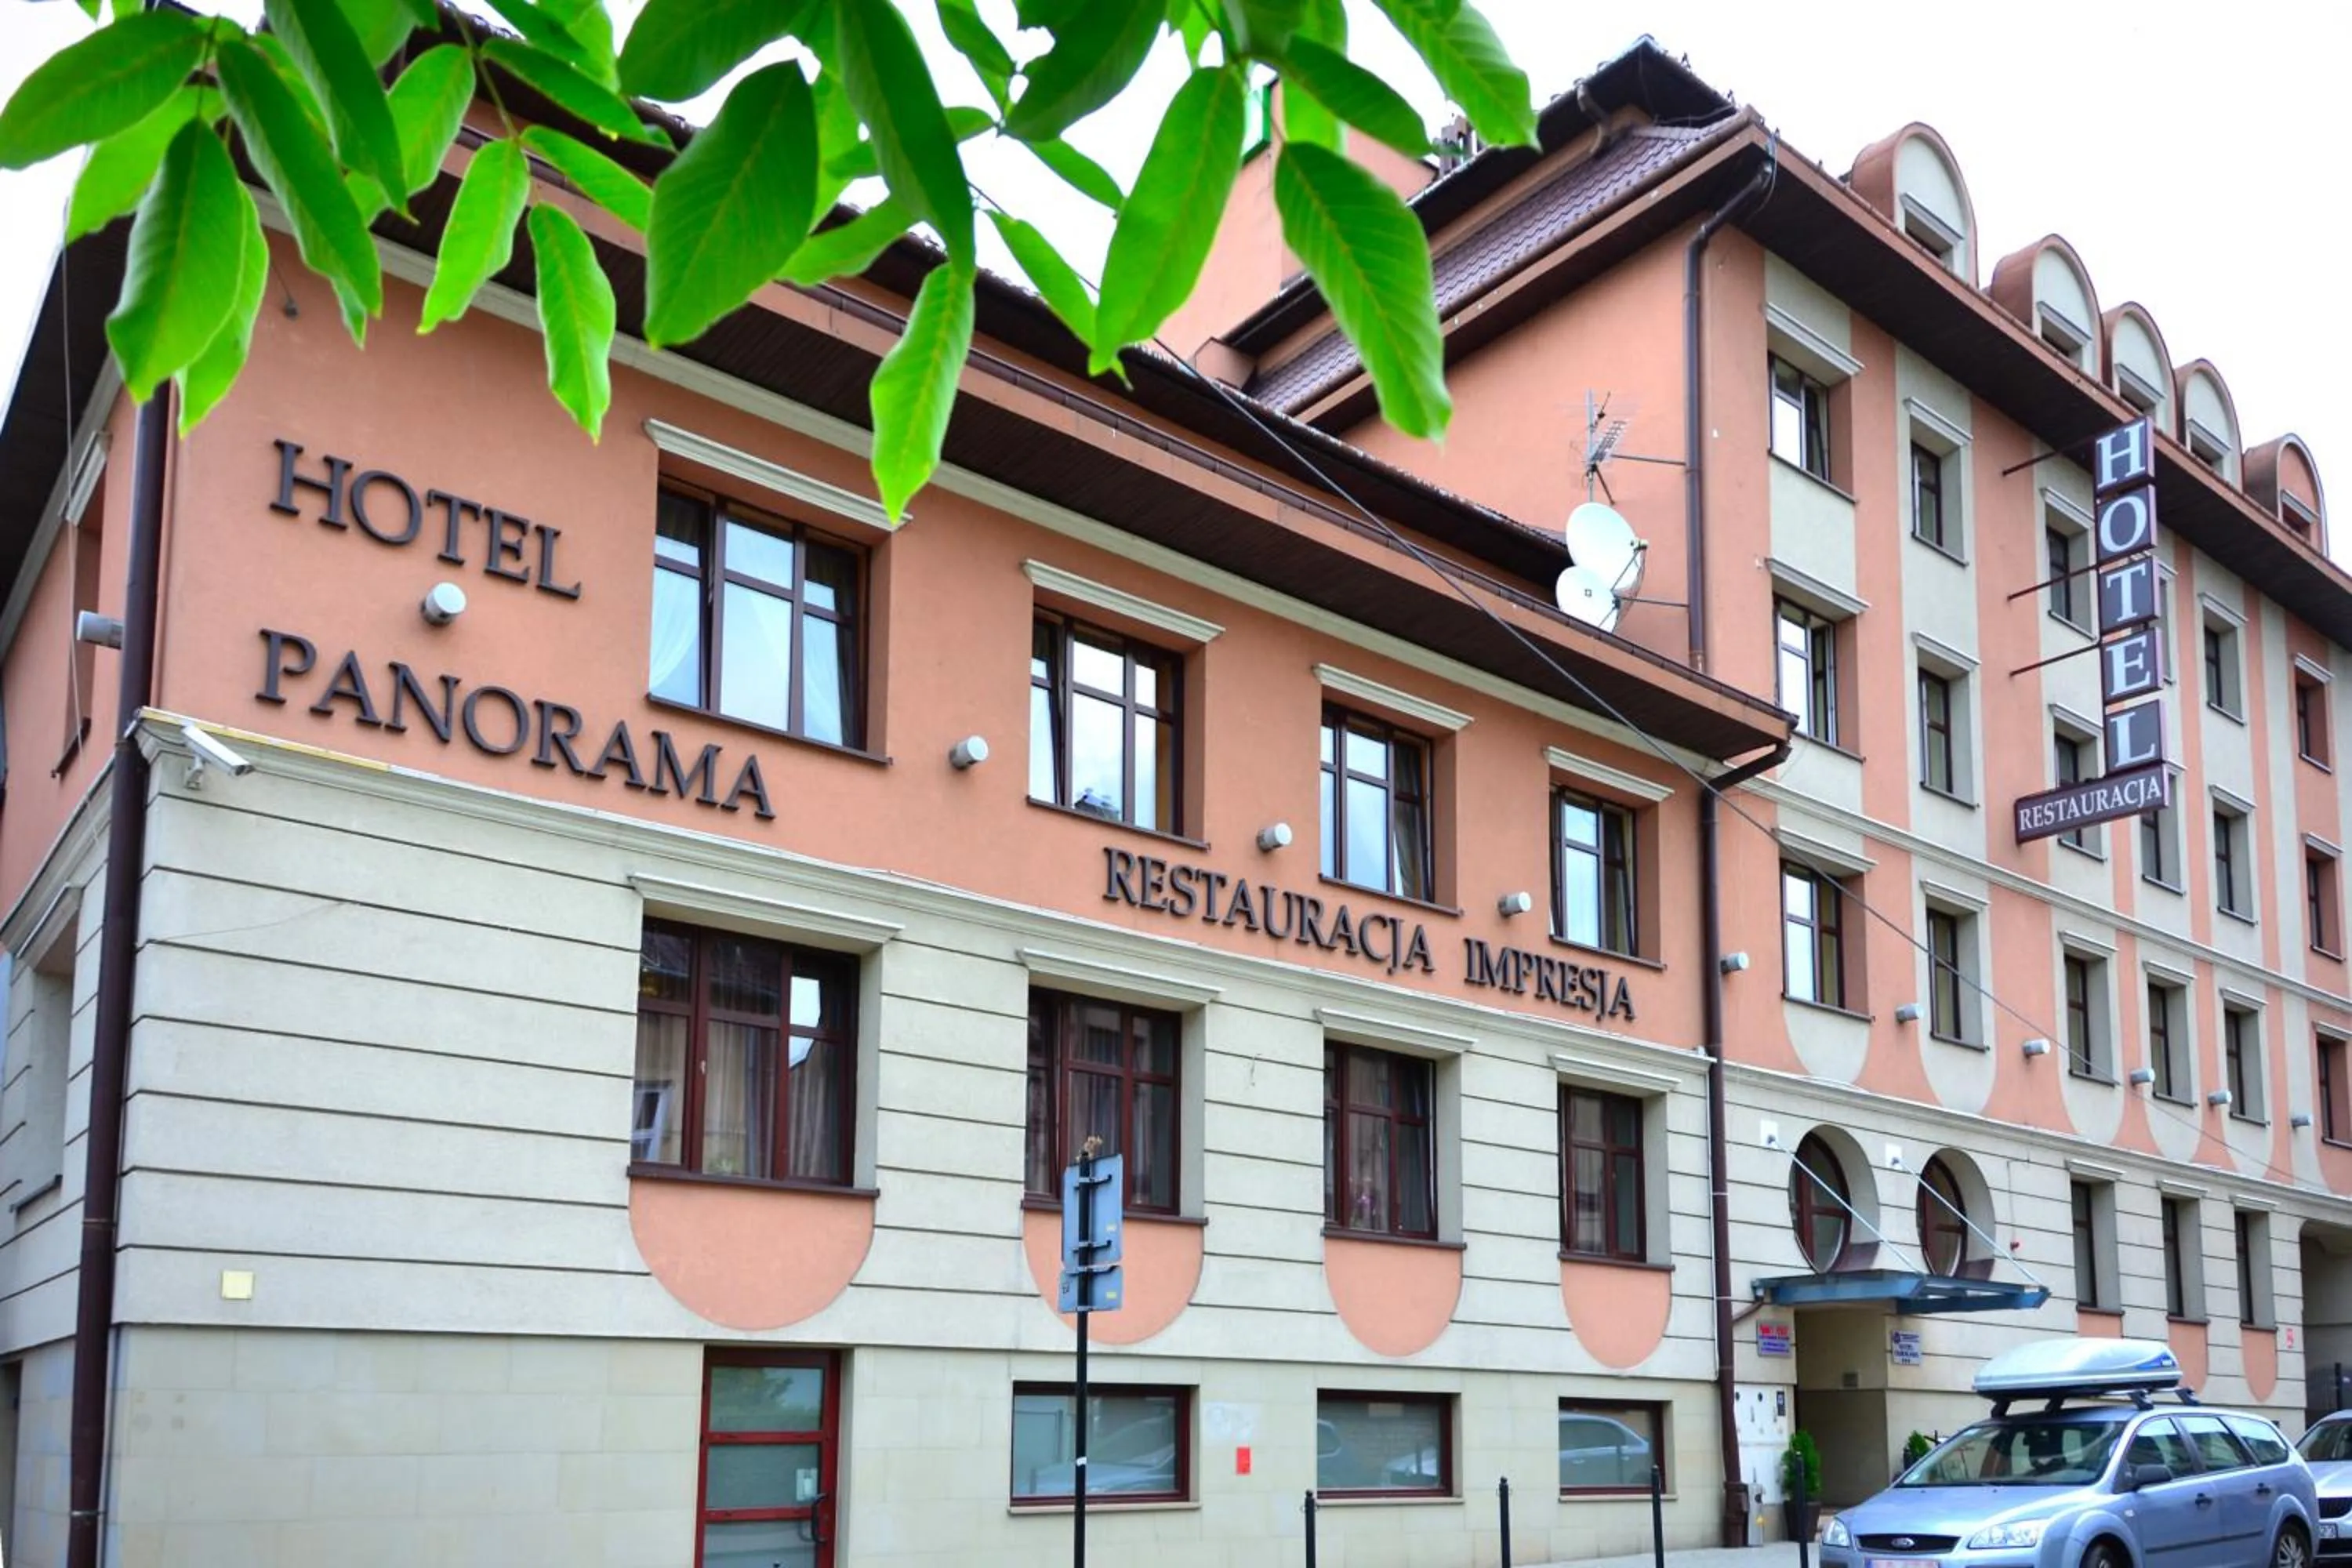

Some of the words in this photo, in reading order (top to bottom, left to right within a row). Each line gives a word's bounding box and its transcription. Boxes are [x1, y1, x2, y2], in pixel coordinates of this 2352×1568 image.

[270, 439, 582, 600] HOTEL
[2096, 421, 2156, 768] HOTEL
[255, 628, 775, 820] PANORAMA
[2019, 776, 2162, 832] RESTAURACJA
[1103, 847, 1435, 975] RESTAURACJA
[1465, 937, 1637, 1021] IMPRESJA
